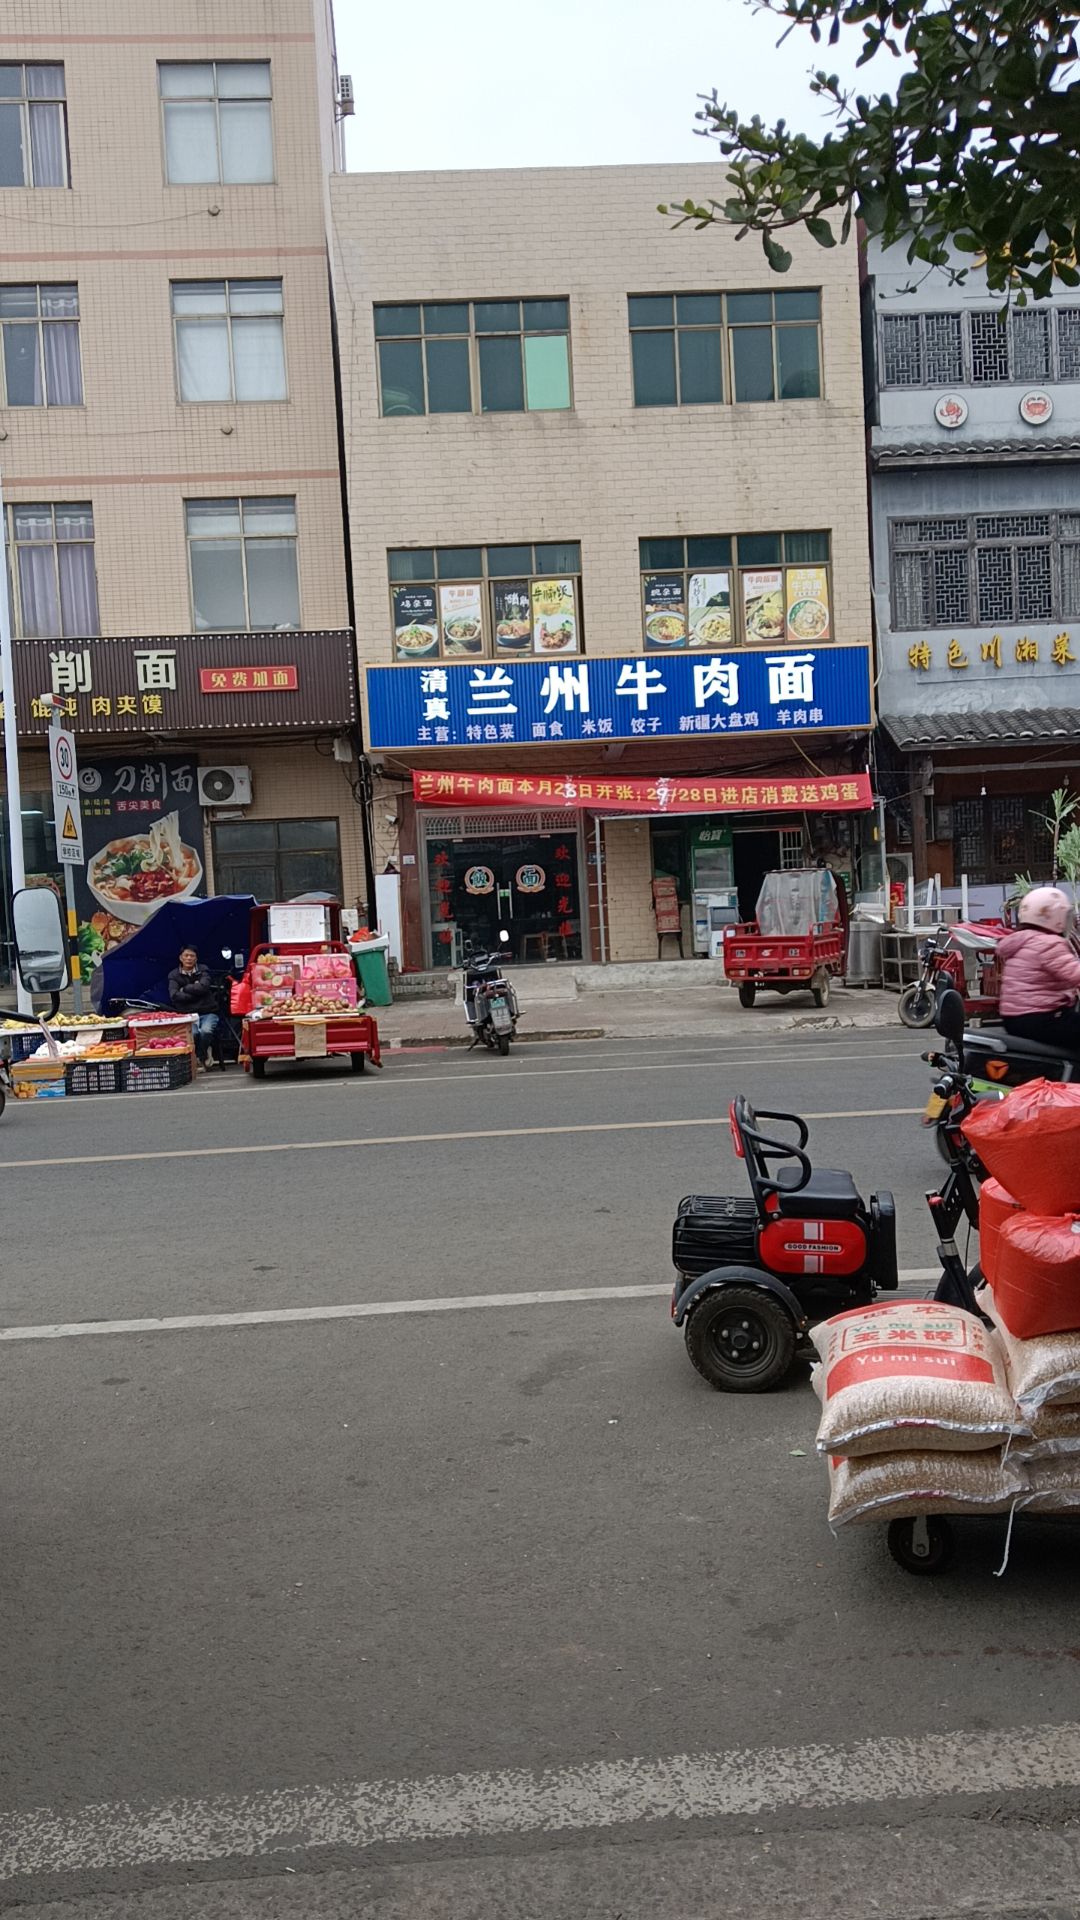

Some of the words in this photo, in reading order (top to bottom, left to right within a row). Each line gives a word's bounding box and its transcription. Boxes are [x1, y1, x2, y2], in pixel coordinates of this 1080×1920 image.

[908, 632, 1077, 671] 特色川湘菜
[211, 670, 288, 688] 免费加面
[467, 653, 816, 715] 兰州牛肉面
[92, 694, 164, 716] 肉夹馍
[420, 668, 450, 721] 清真
[466, 723, 515, 741] 特色菜
[531, 720, 564, 738] 面食
[581, 718, 613, 735] 米饭
[631, 717, 662, 733] 饺子
[679, 711, 759, 732] 新疆大盘鸡
[776, 707, 824, 726] 羊肉串
[60, 747, 69, 768] 30
[112, 762, 193, 800] 刀削面
[116, 800, 162, 812] 舌尖美食
[852, 1329, 954, 1343] 玉米碎
[856, 1354, 883, 1366] Yu
[891, 1353, 917, 1363] mi
[926, 1355, 957, 1367] sui
